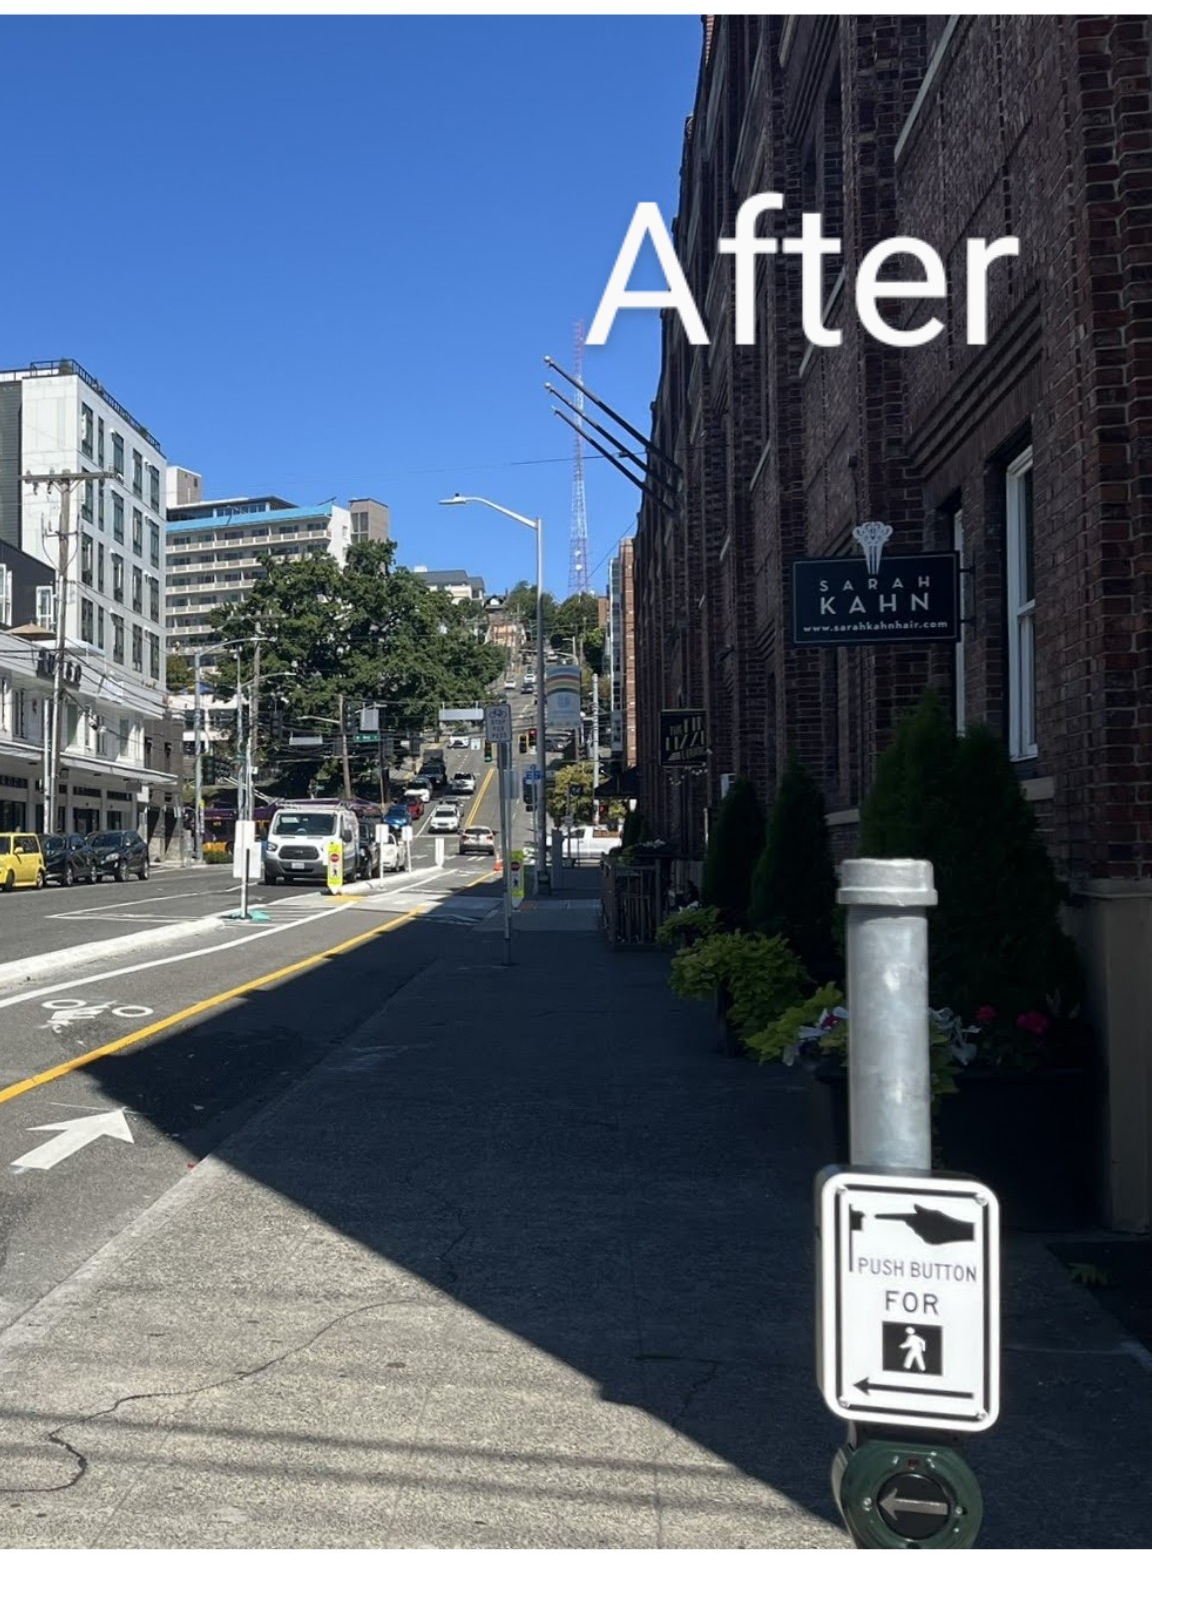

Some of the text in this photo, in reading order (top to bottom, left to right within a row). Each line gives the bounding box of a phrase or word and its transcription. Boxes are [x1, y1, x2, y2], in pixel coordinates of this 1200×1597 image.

[819, 575, 930, 592] SARAH
[820, 592, 929, 615] KAHN
[803, 620, 948, 632] www.sarahkahnhair.com
[858, 1257, 976, 1282] PUSH BUTTON
[885, 1290, 939, 1315] FOR
